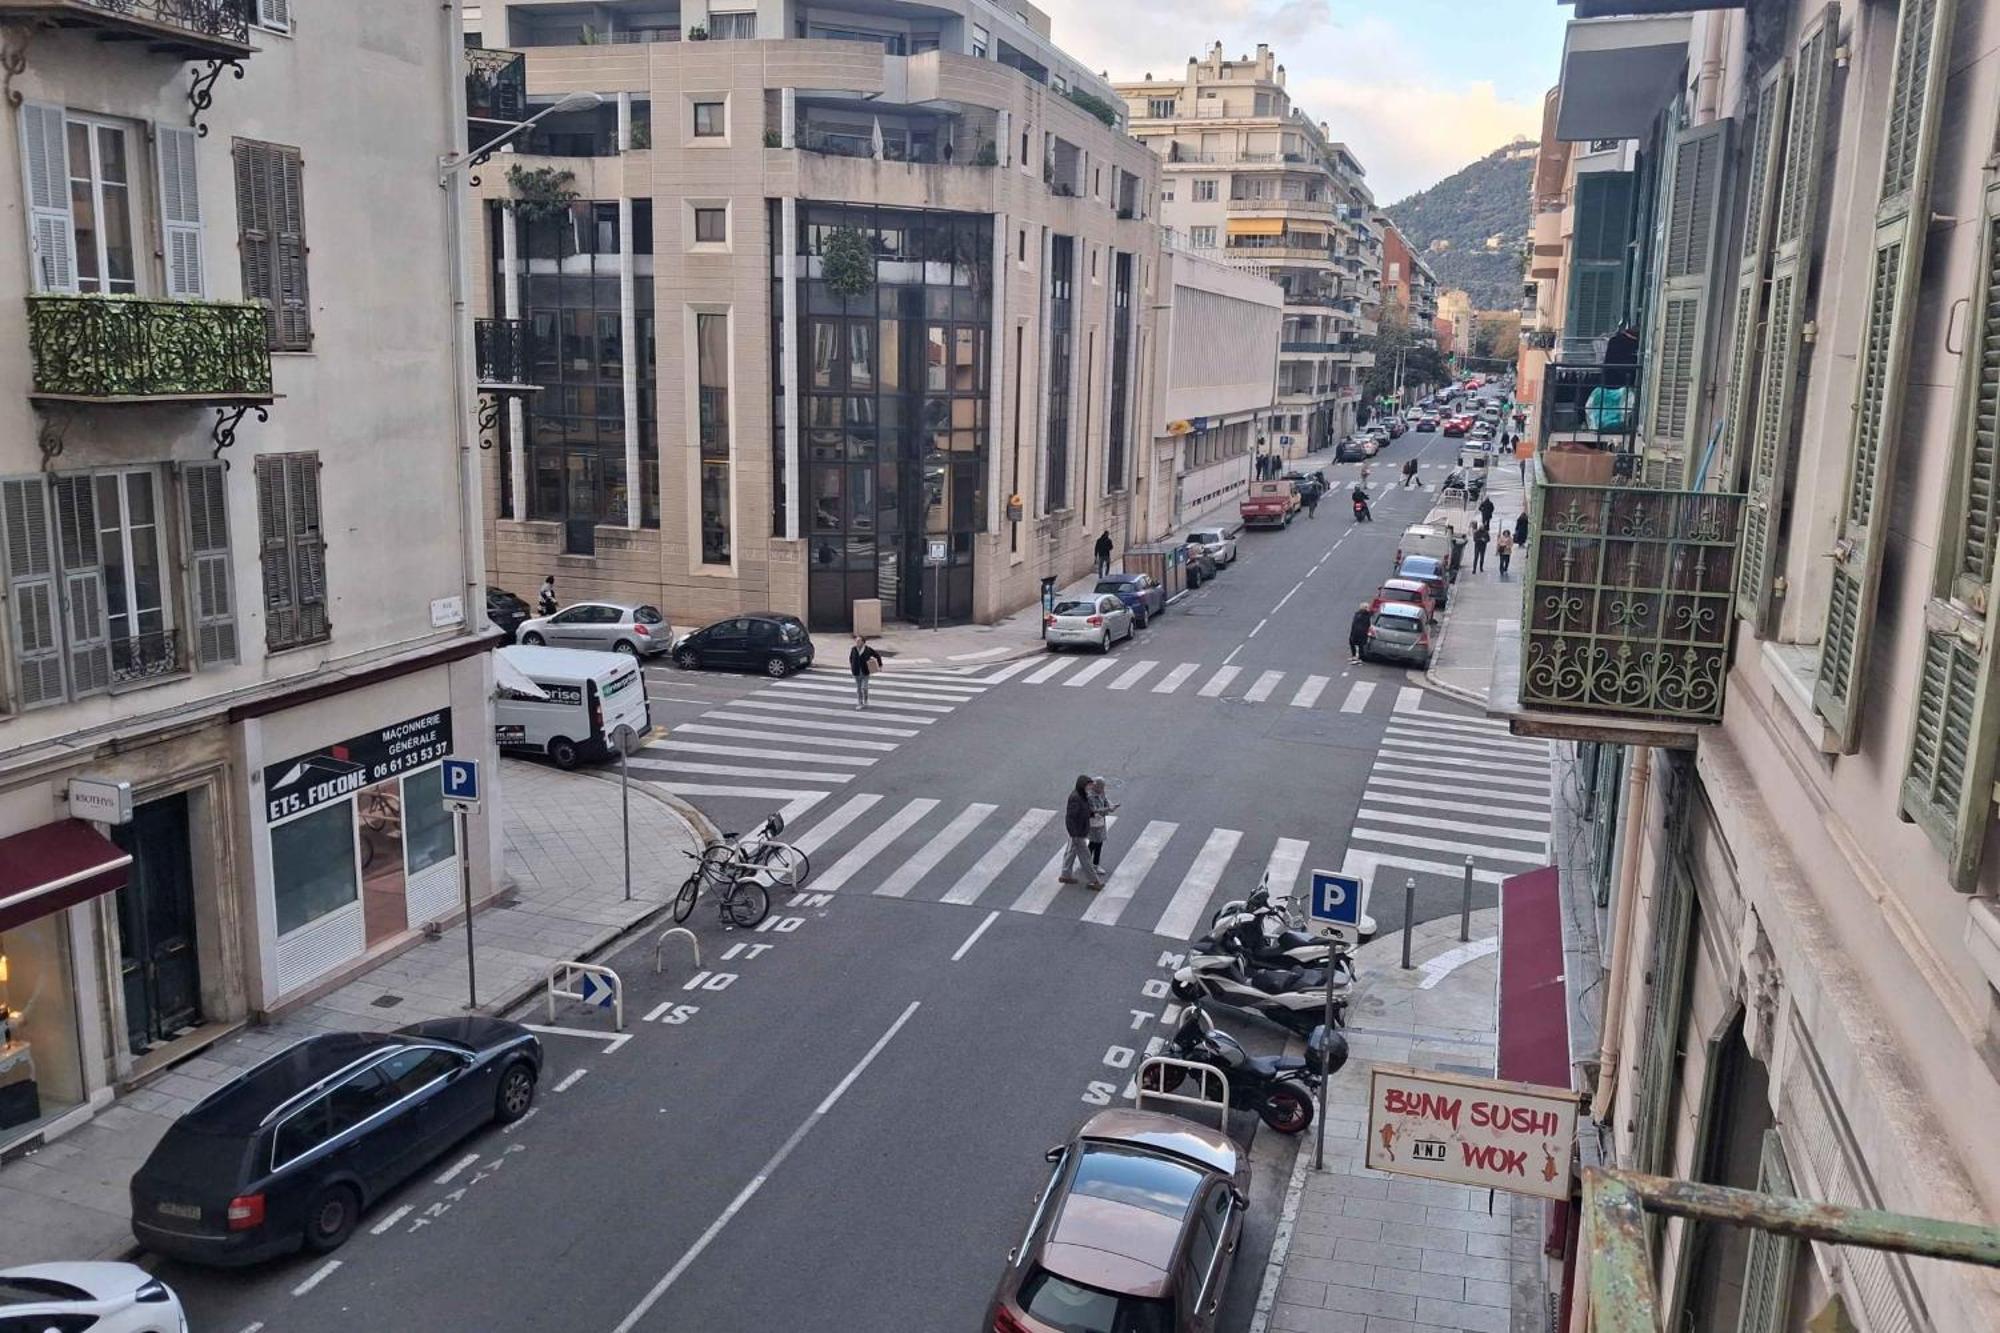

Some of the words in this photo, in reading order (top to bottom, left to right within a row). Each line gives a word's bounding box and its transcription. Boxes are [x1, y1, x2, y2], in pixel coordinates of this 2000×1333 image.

[382, 714, 440, 741] MAÇONNERIE
[388, 731, 437, 755] GÉNÉRALE
[374, 765, 387, 778] 06
[390, 758, 403, 773] 61
[405, 752, 418, 767] 33
[420, 747, 433, 763] 53
[435, 742, 448, 758] 37
[270, 793, 305, 820] ETS.
[308, 769, 368, 806] FOCONE
[451, 766, 467, 790] P
[1324, 883, 1346, 912] P
[1470, 1102, 1558, 1137] SUSHI
[1413, 1143, 1446, 1158] AND
[1461, 1142, 1527, 1177] WOK
[407, 1144, 526, 1233] PAYANT
